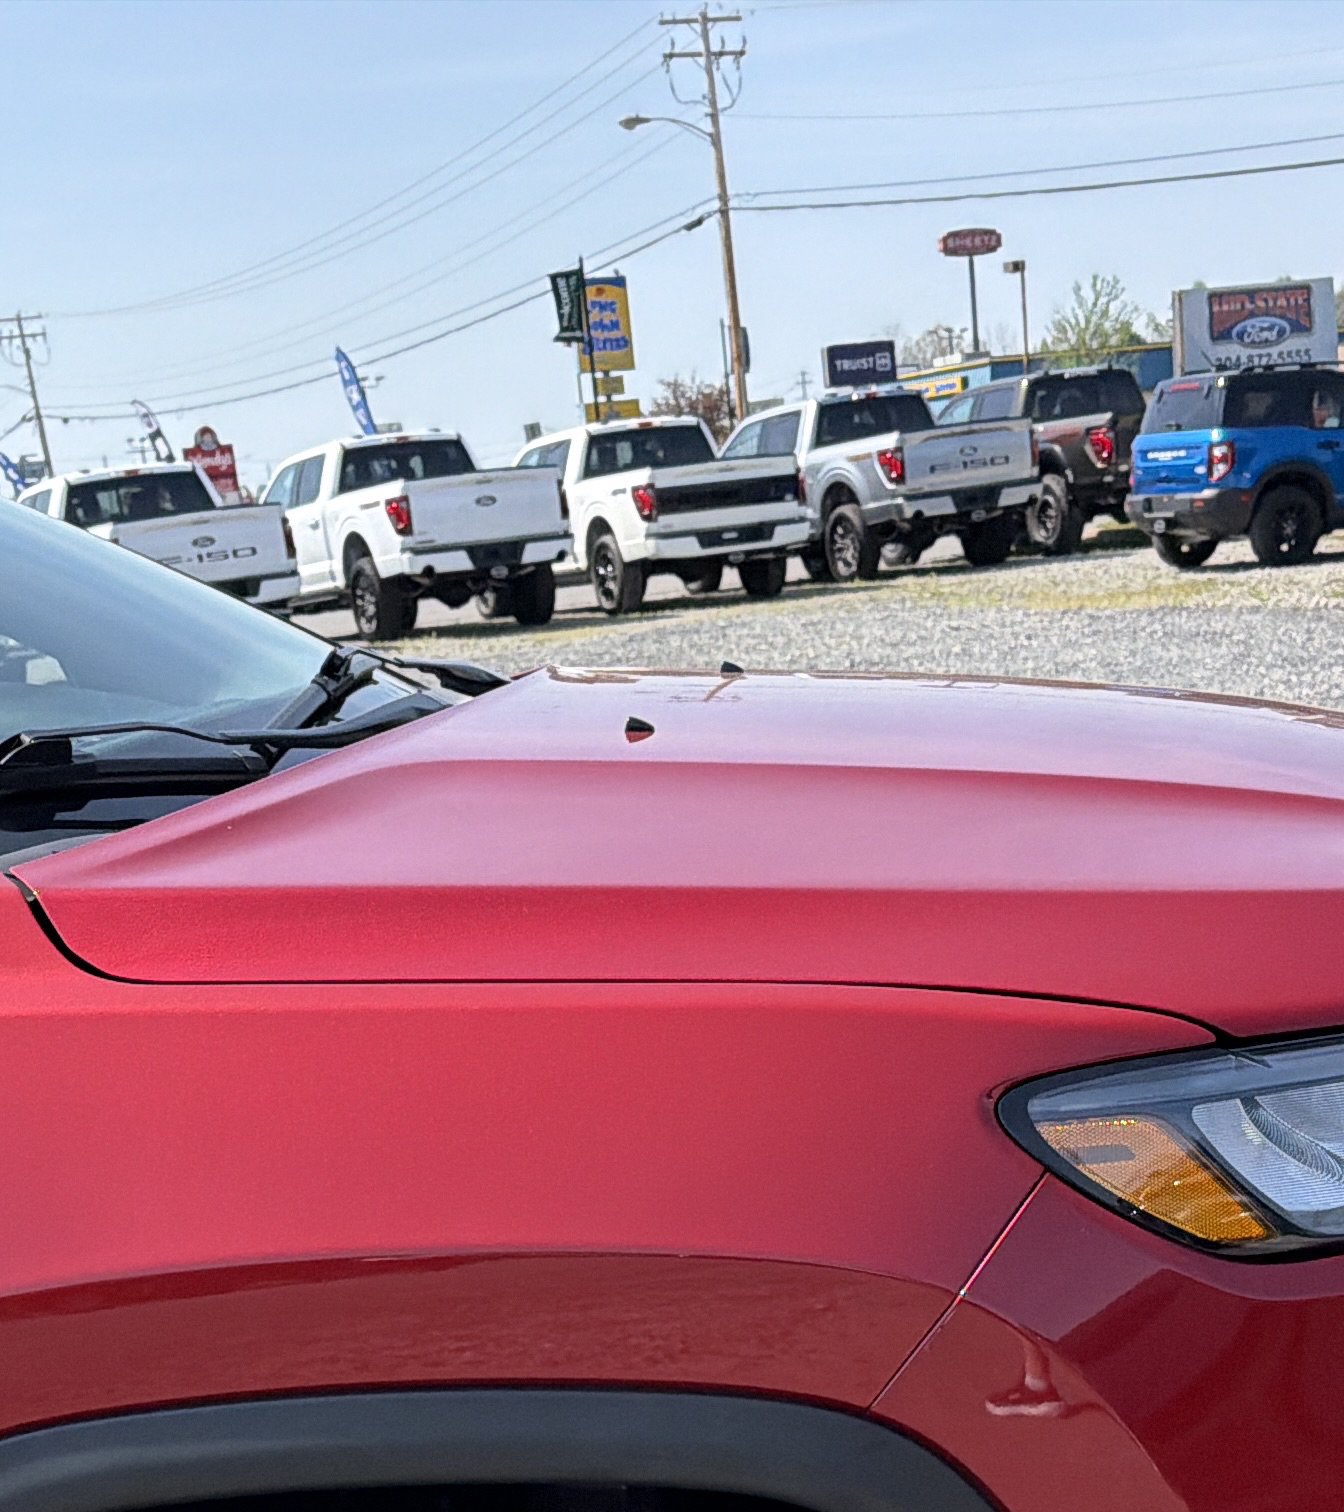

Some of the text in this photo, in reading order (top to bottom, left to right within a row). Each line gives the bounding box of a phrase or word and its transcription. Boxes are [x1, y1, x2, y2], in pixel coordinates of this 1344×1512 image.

[1243, 321, 1279, 344] Ford
[835, 357, 874, 371] TRUIST
[929, 454, 1010, 474] F-150
